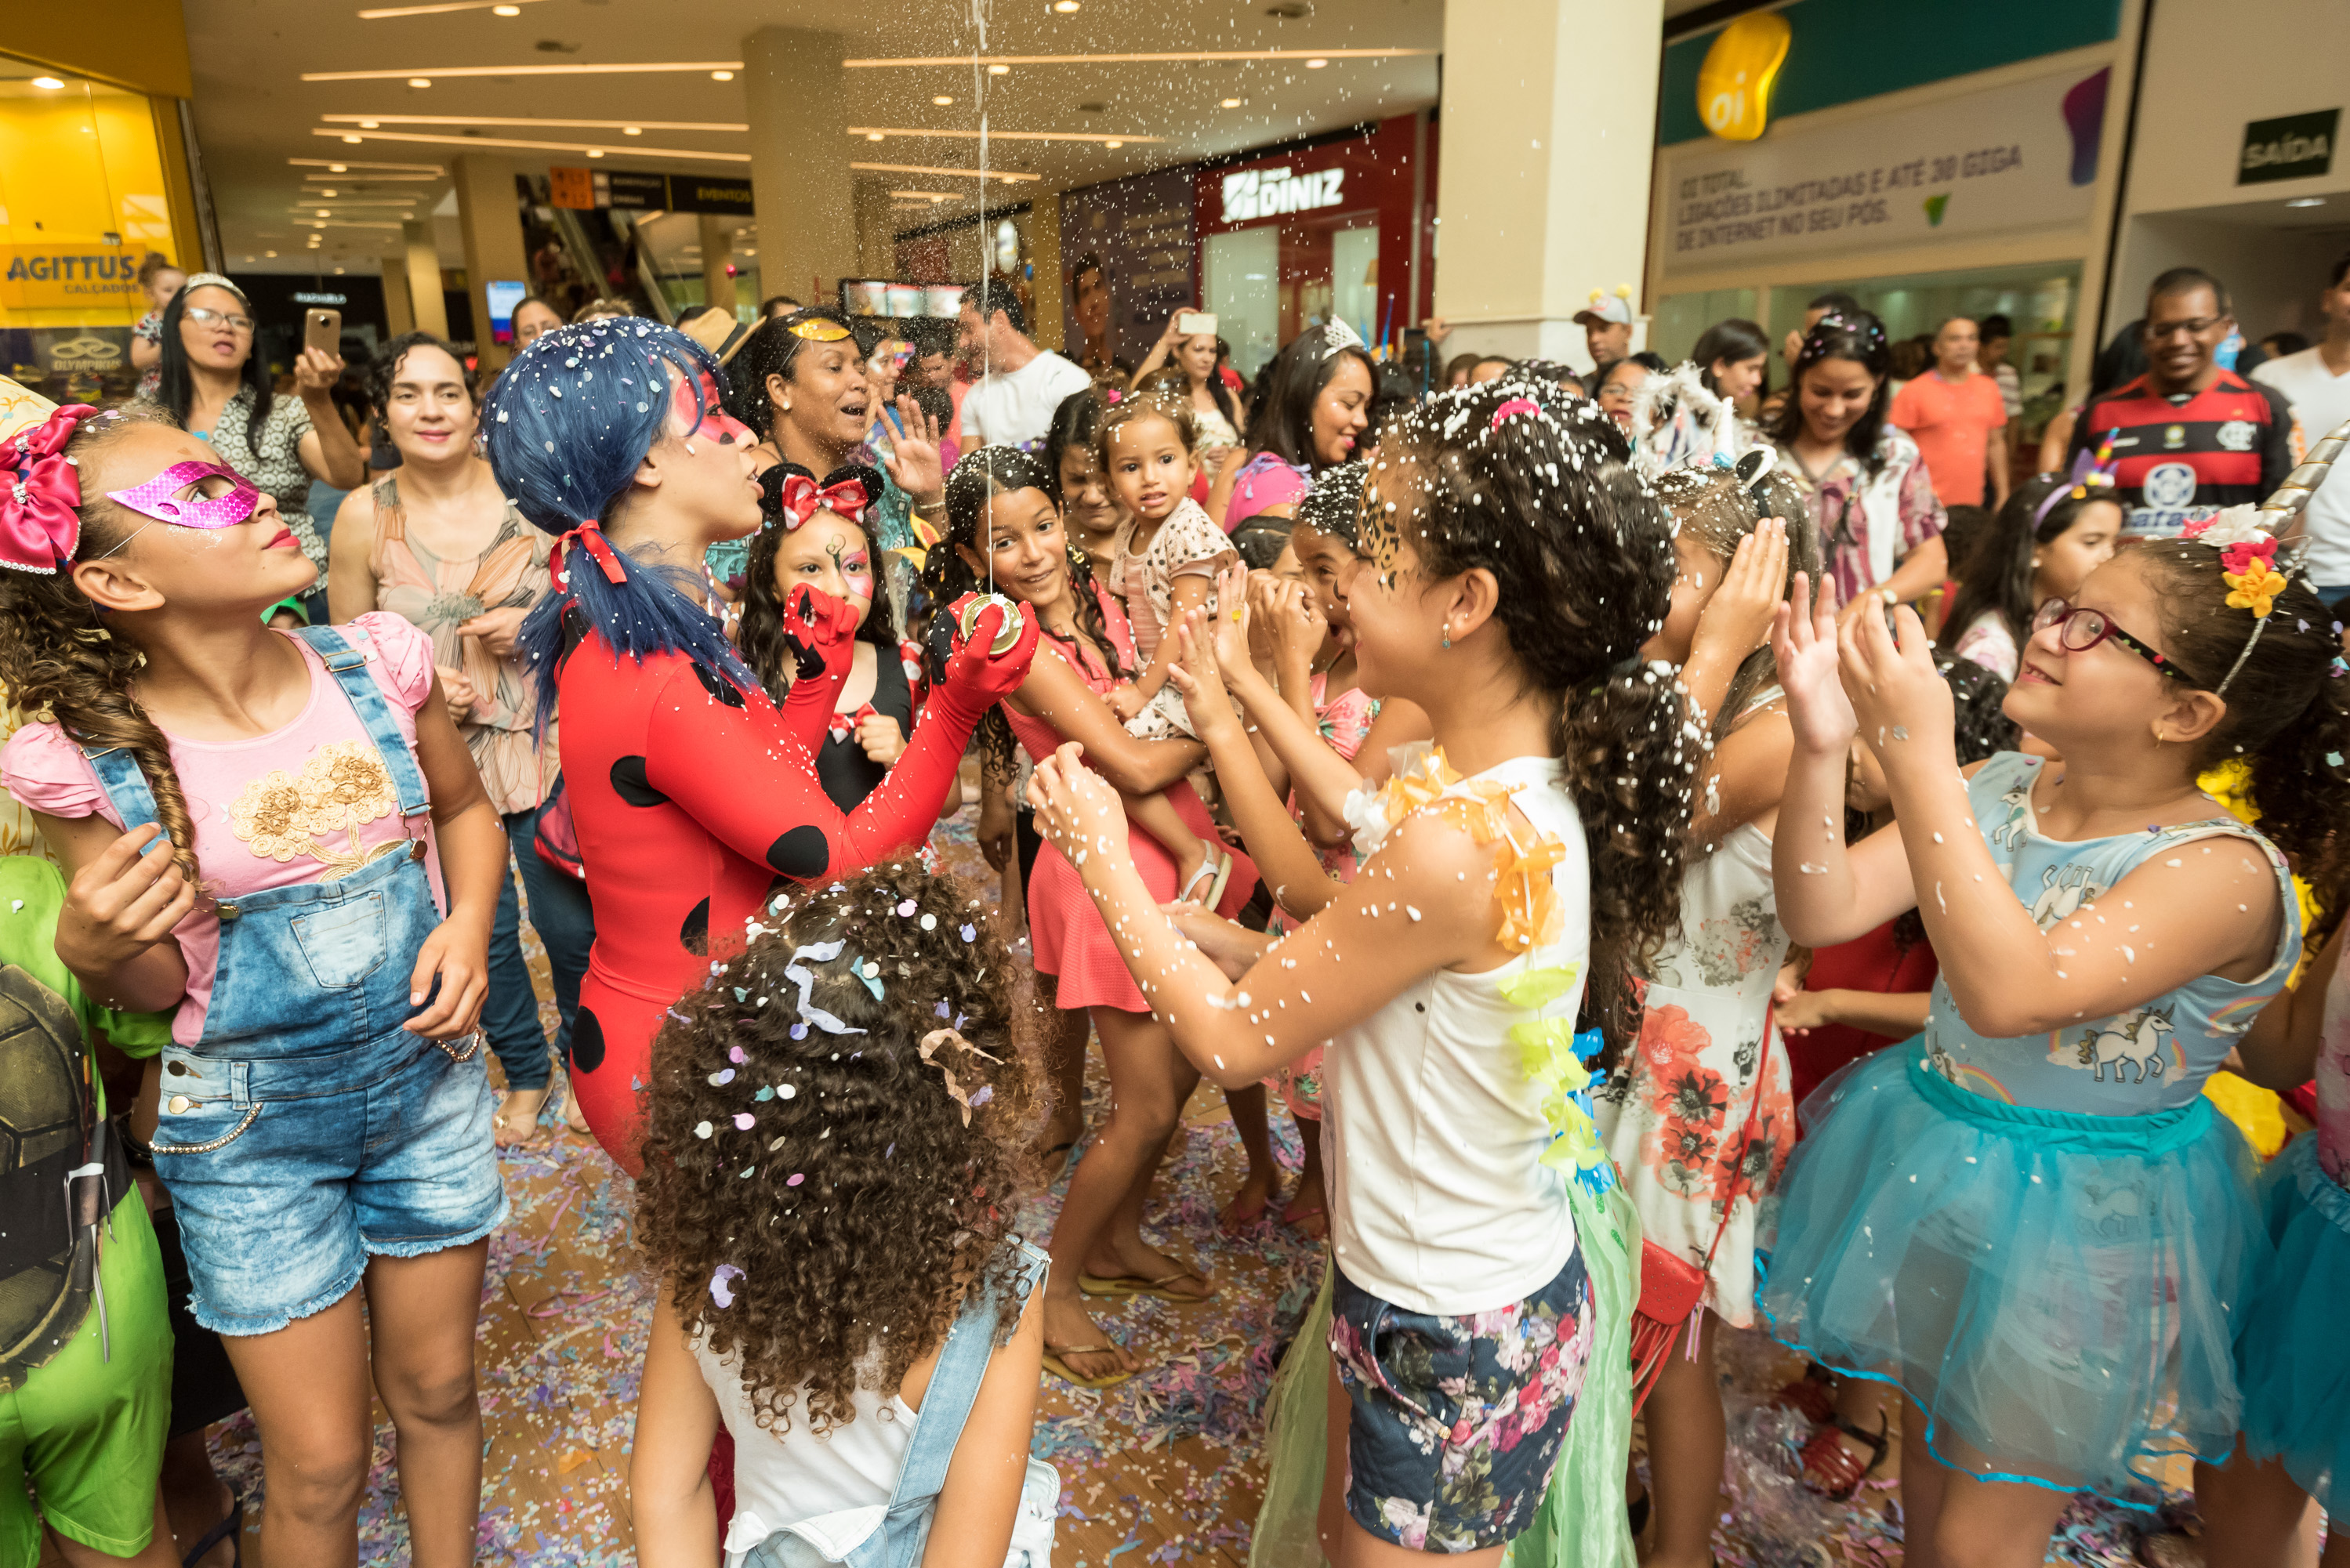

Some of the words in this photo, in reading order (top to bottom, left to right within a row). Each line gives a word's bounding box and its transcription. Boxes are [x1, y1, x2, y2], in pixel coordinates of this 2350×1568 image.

[1709, 69, 1746, 132] oi
[1888, 158, 1926, 189] ATÉ
[1962, 144, 2022, 179] GIGA
[2243, 132, 2328, 169] SAÍDA
[697, 186, 752, 204] EVENTOS
[1259, 168, 1344, 217] DINIZ
[7, 255, 136, 281] AGITTUS
